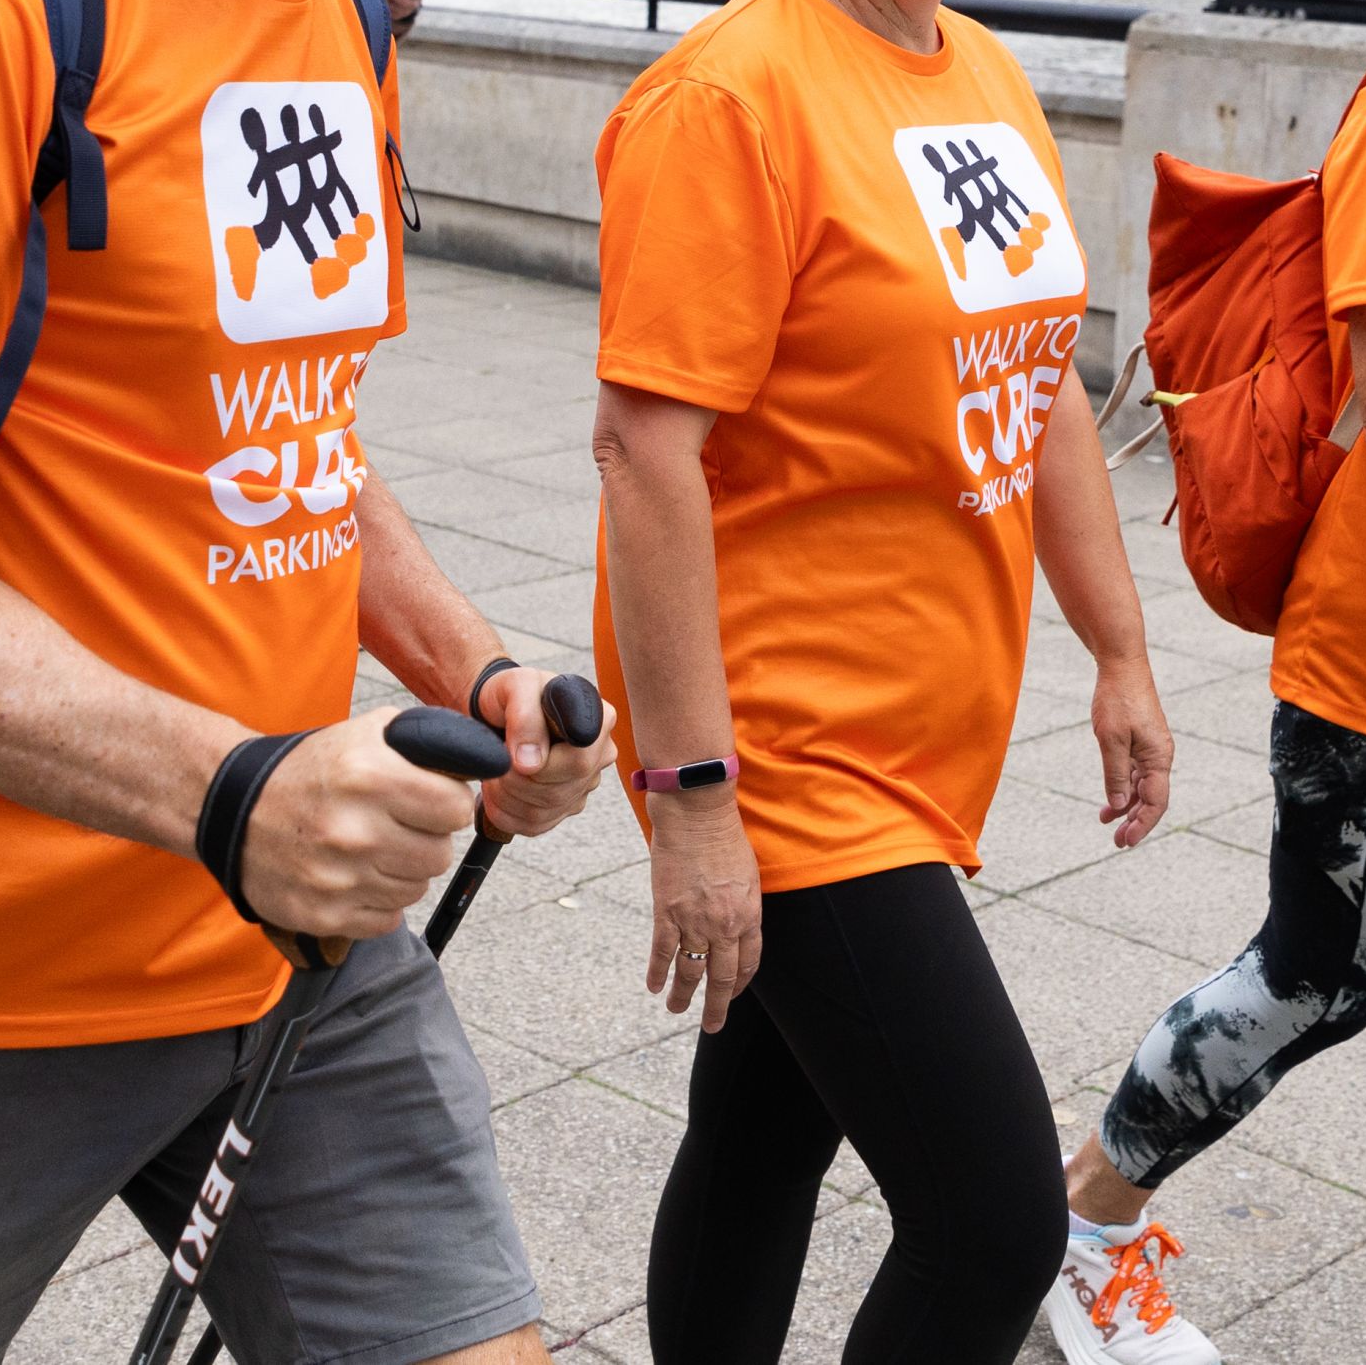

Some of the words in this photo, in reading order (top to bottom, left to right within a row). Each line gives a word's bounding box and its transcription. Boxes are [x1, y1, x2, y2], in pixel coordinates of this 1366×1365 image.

[953, 318, 1039, 384] WALK
[1034, 314, 1082, 359] TO
[209, 354, 344, 439] WALK
[957, 366, 1061, 476] CURE
[207, 511, 359, 584] PARKINSO
[172, 1118, 253, 1285] LEKI
[1062, 1265, 1120, 1343] HOA
